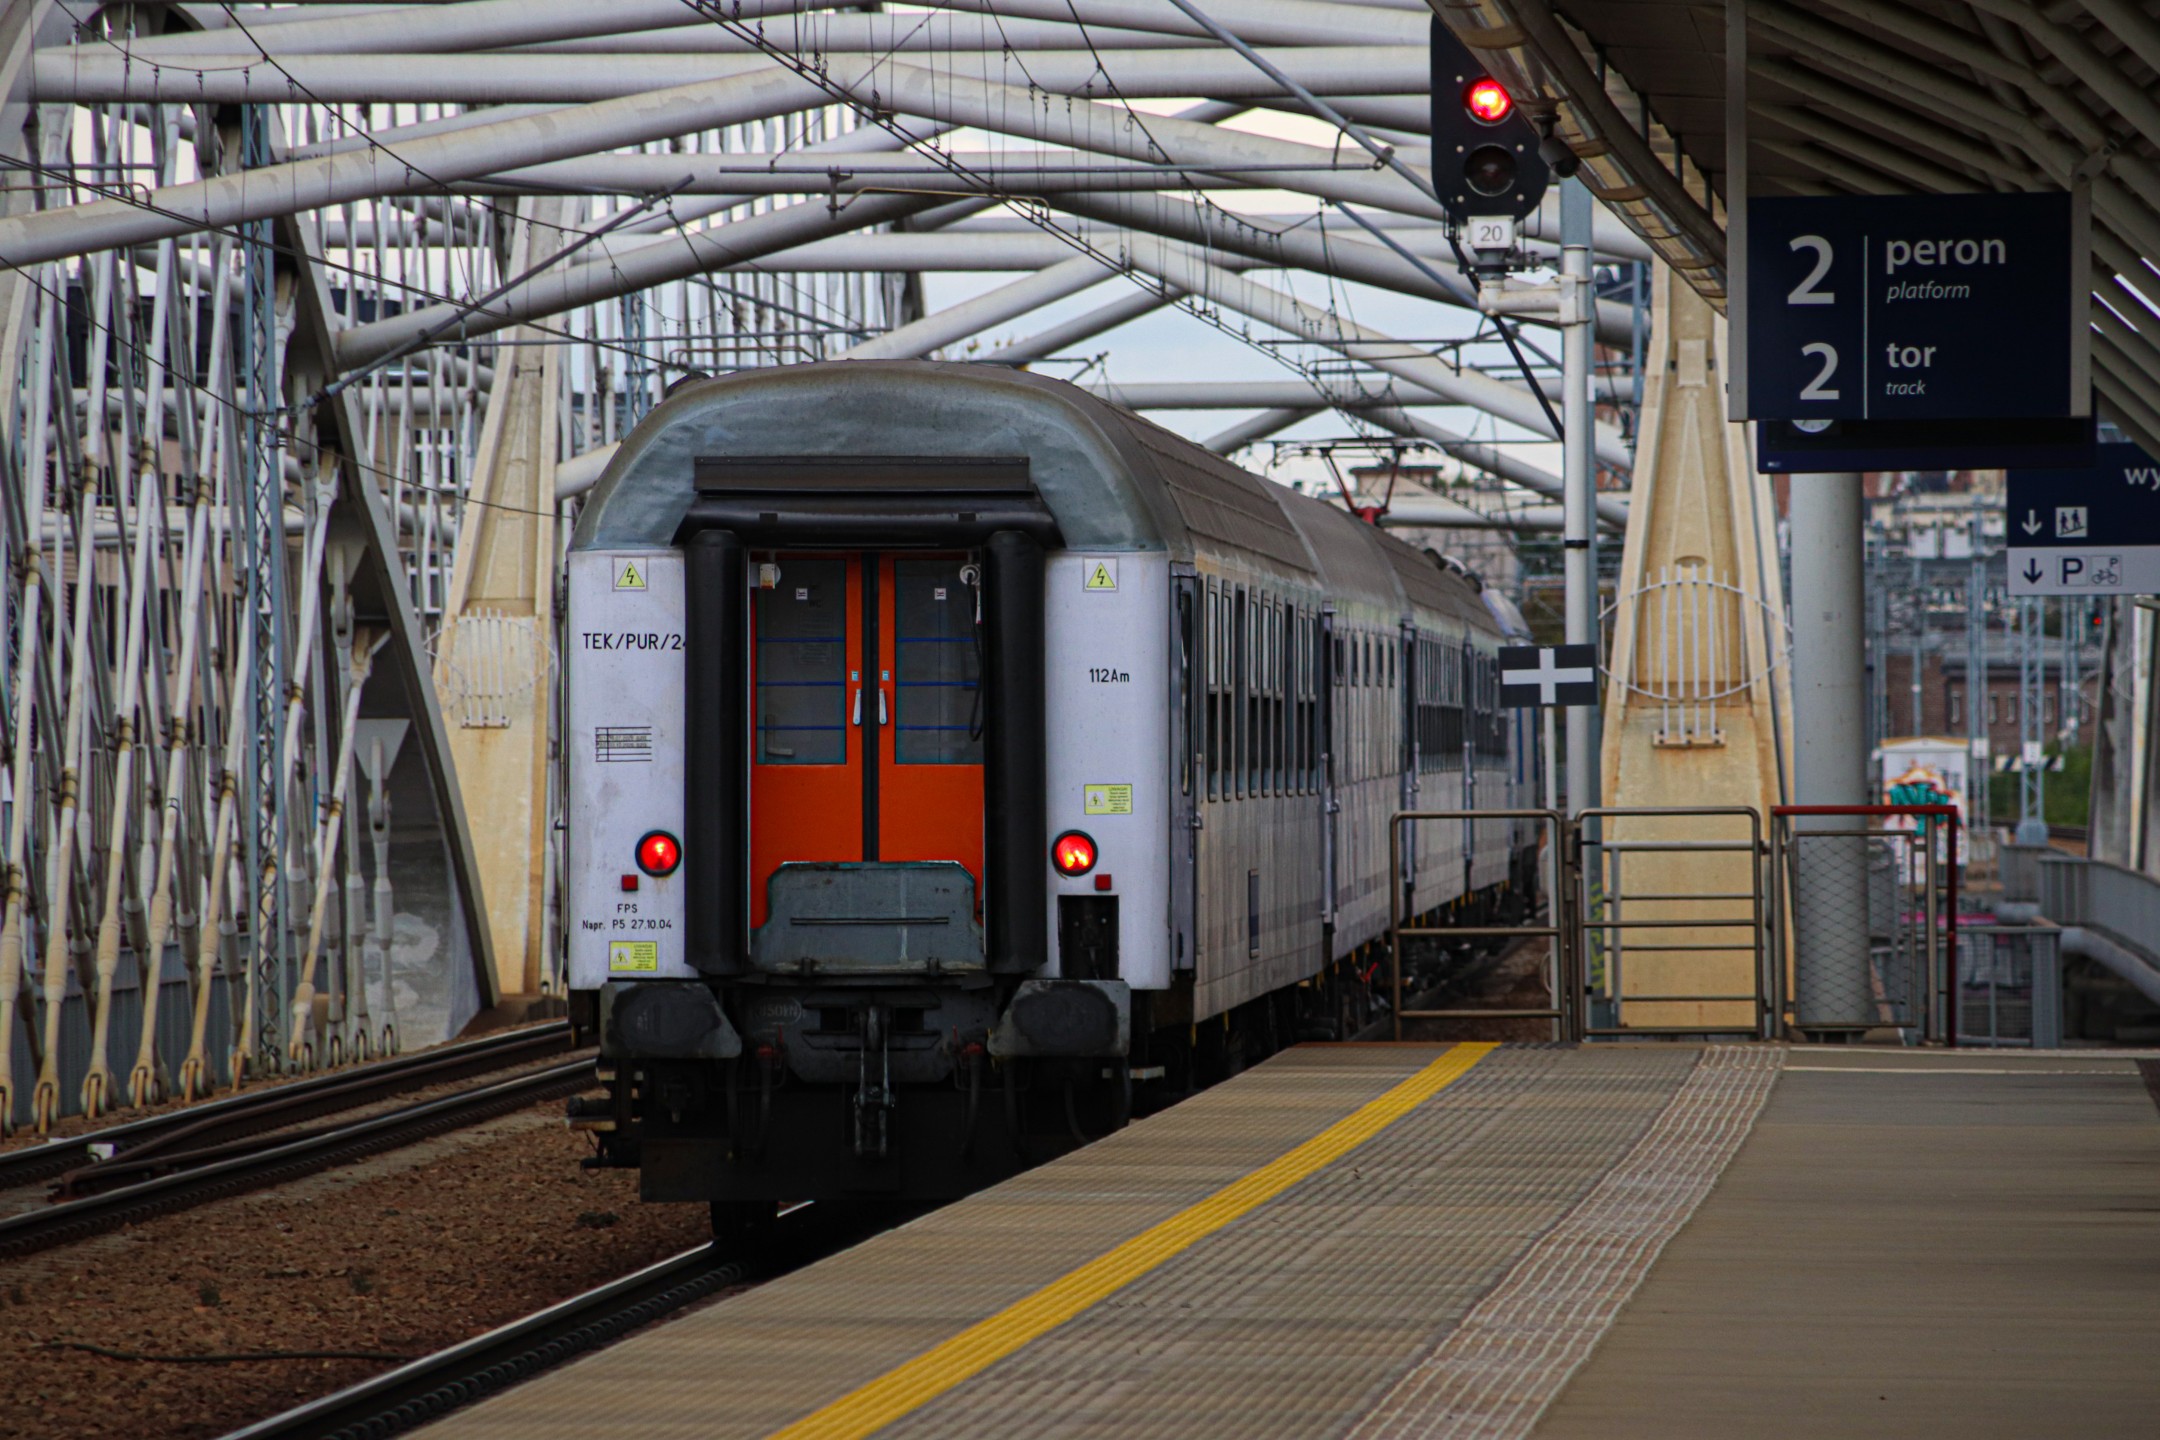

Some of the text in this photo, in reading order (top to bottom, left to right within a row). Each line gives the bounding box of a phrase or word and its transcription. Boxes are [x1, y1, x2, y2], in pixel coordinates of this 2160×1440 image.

[1480, 225, 1503, 241] 20
[1788, 234, 2006, 304] 2 peron
[1886, 280, 1970, 304] platform
[1800, 342, 1937, 400] 2 tor
[1886, 379, 1926, 395] track
[2109, 557, 2119, 568] P
[2062, 558, 2083, 584] P
[582, 633, 686, 650] TEK/PUR/2
[1089, 668, 1130, 683] 112Am
[617, 903, 638, 914] FPS
[582, 920, 606, 932] Napr.
[631, 919, 672, 930] 27.10.04
